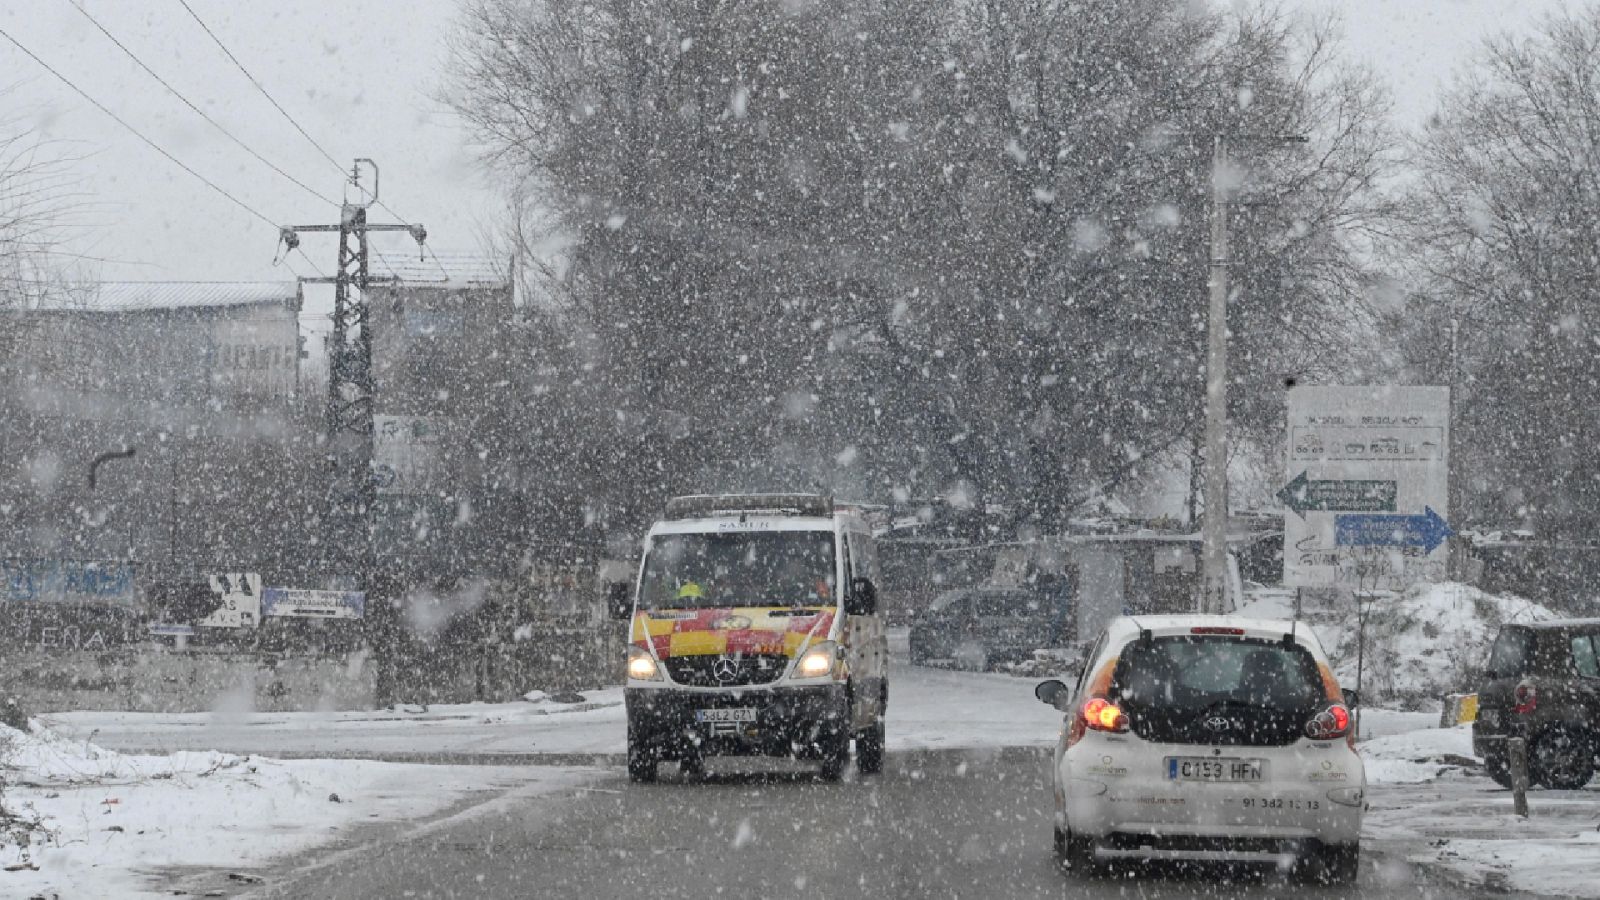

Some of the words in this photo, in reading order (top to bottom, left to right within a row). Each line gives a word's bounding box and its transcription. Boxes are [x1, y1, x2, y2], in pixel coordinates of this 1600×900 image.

[1230, 763, 1262, 781] HFN
[1242, 797, 1255, 808] 91
[1306, 800, 1320, 811] 13
